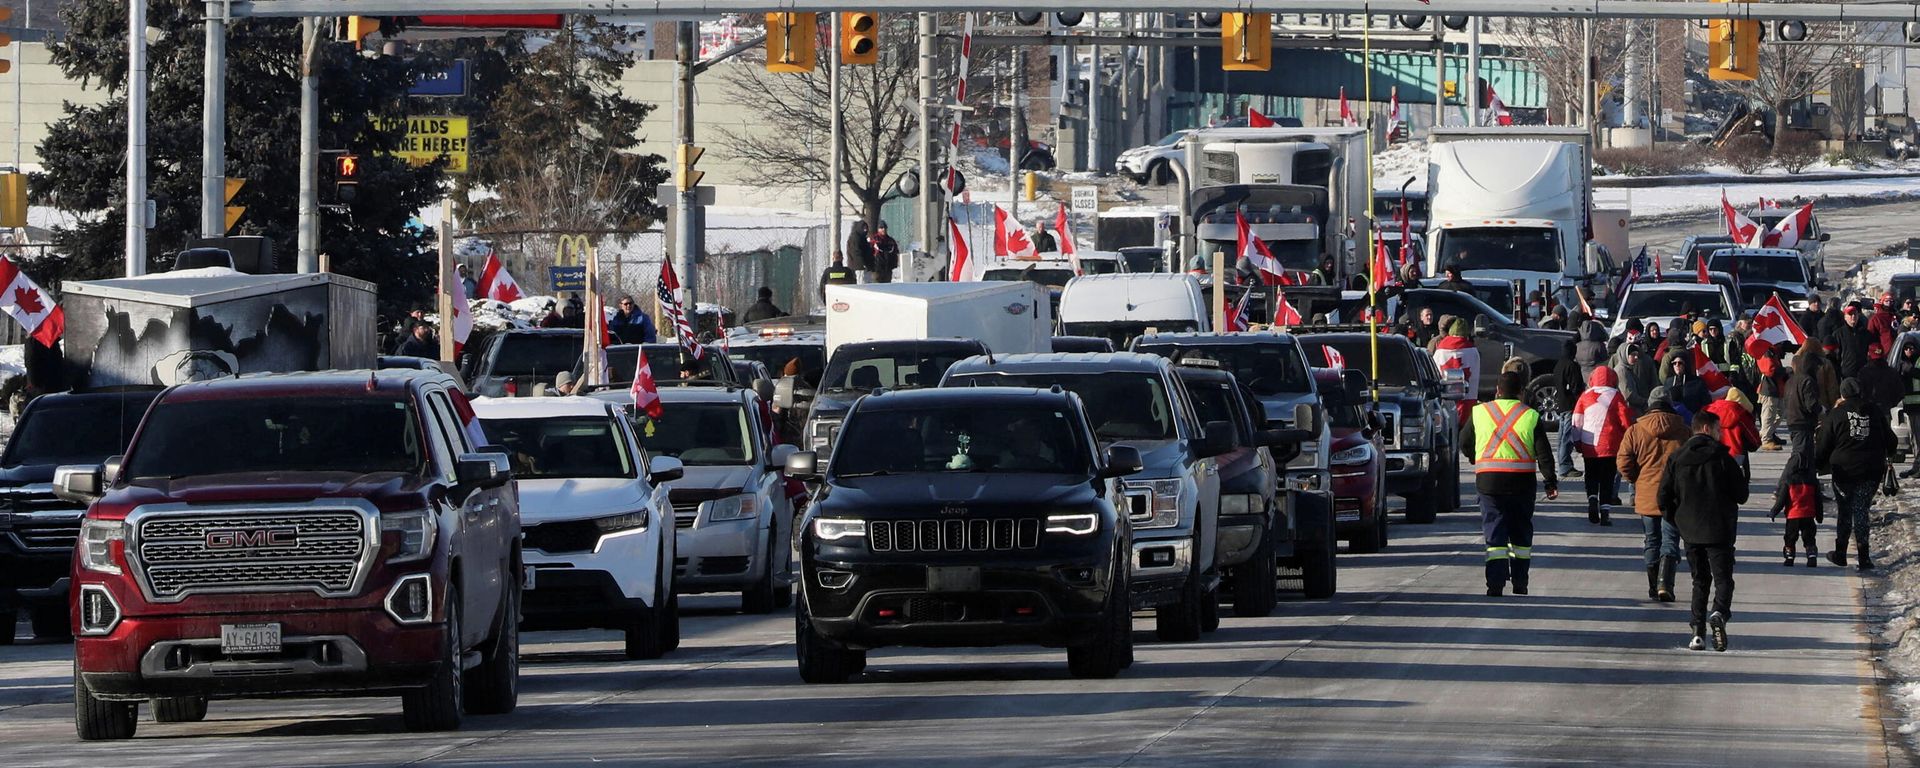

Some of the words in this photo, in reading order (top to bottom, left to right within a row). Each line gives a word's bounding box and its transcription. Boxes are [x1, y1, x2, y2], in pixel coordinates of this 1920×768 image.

[422, 138, 467, 152] HERE!
[1074, 199, 1095, 209] CLOSED
[940, 506, 968, 516] Jeep
[206, 529, 296, 549] GMC
